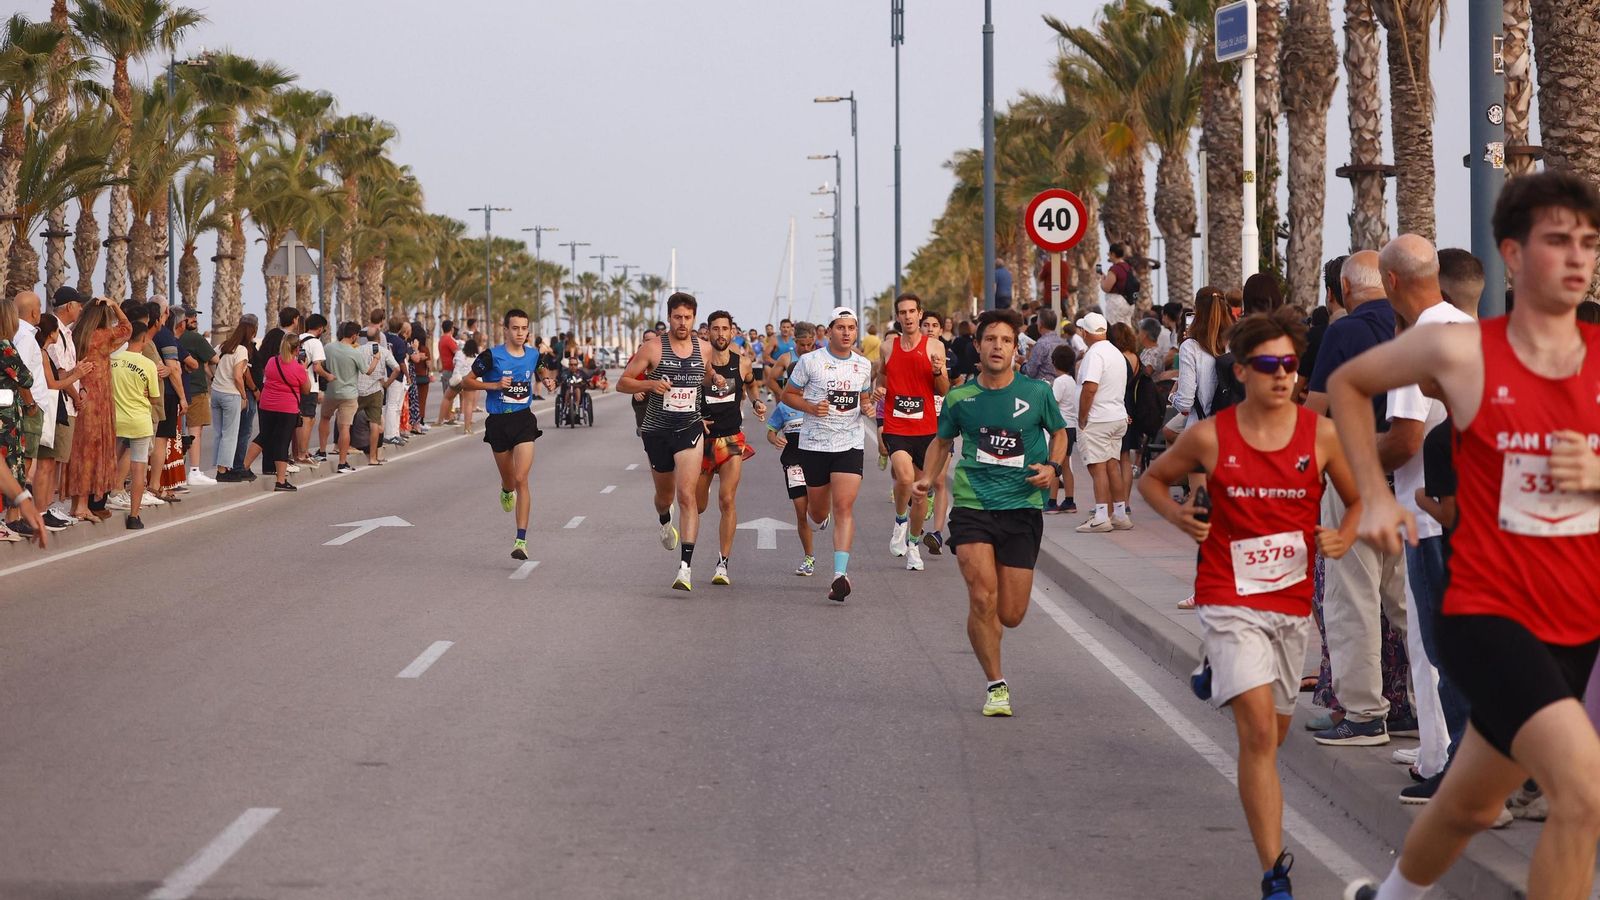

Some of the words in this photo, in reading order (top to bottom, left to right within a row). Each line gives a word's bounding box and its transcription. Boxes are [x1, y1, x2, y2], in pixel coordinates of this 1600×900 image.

[1038, 207, 1071, 231] 40
[836, 380, 851, 391] 26
[671, 392, 691, 400] 4181
[833, 395, 854, 404] 2818
[898, 399, 920, 408] 2093
[989, 435, 1017, 449] 1173
[1496, 432, 1540, 450] SAN
[1226, 486, 1256, 498] SAN
[1258, 487, 1307, 500] PEDRO
[1243, 544, 1295, 566] 3378
